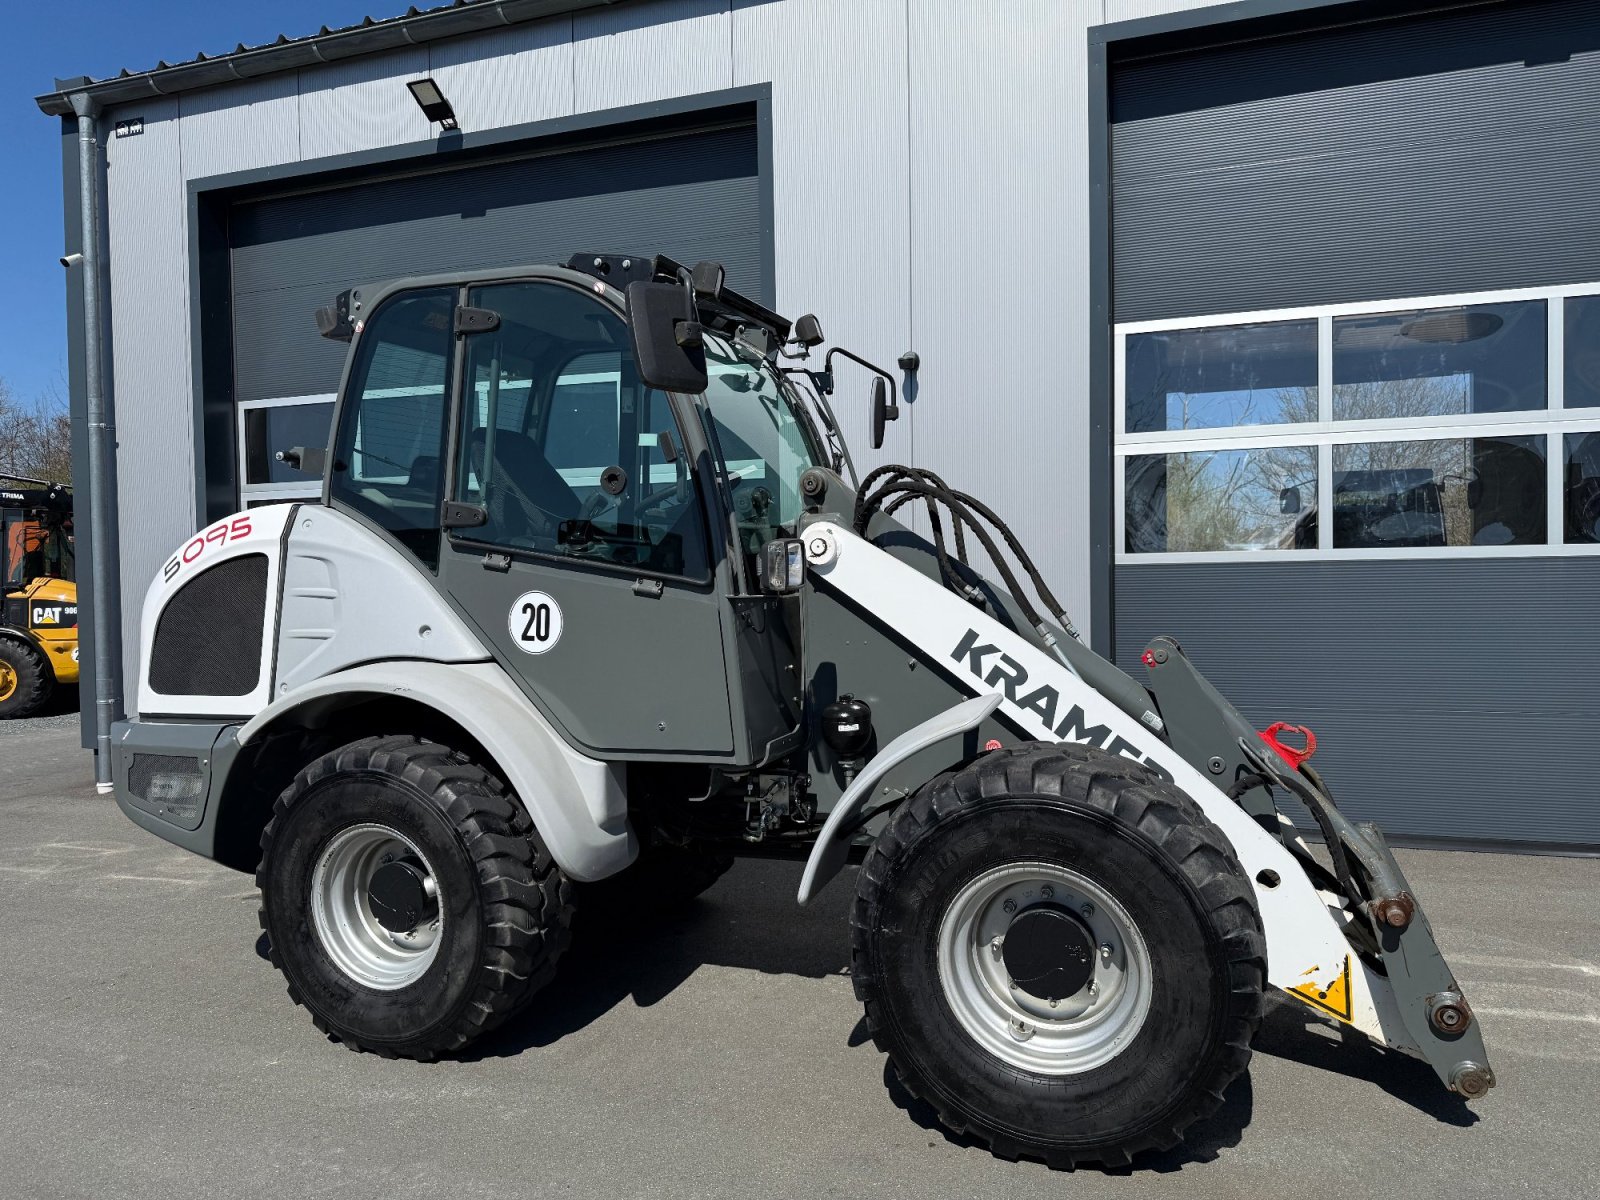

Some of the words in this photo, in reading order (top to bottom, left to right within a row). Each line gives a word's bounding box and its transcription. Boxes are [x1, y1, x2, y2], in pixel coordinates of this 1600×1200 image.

[1, 492, 24, 500] TRIMA
[164, 516, 252, 584] 5095
[33, 607, 62, 624] CAT
[521, 603, 551, 642] 20
[950, 628, 1176, 784] KRAM
